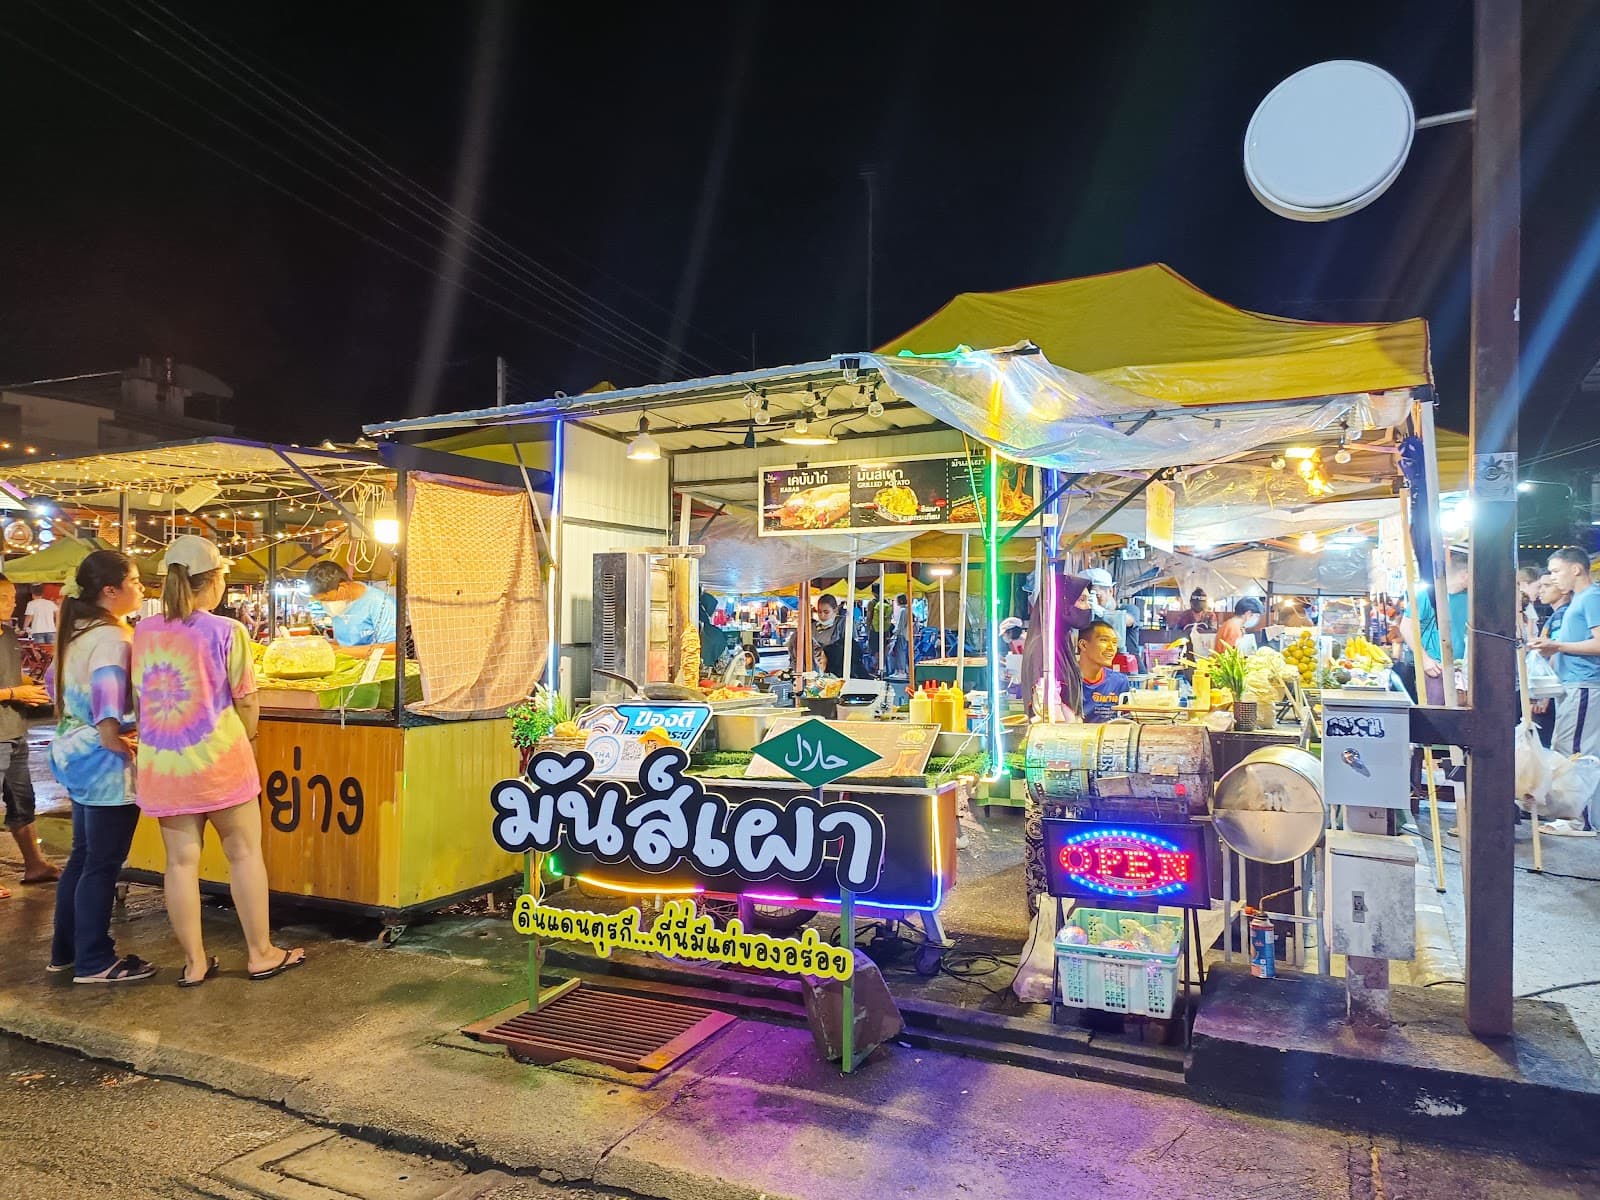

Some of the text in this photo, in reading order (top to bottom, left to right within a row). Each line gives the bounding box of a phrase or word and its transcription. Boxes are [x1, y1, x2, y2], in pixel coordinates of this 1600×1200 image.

[787, 470, 828, 486] เคบับไก่
[634, 710, 696, 728] ของดี
[784, 733, 849, 772] حلال
[266, 746, 365, 835] ย่าง
[497, 754, 873, 884] มันส์เผา
[1059, 845, 1191, 882] OPEN
